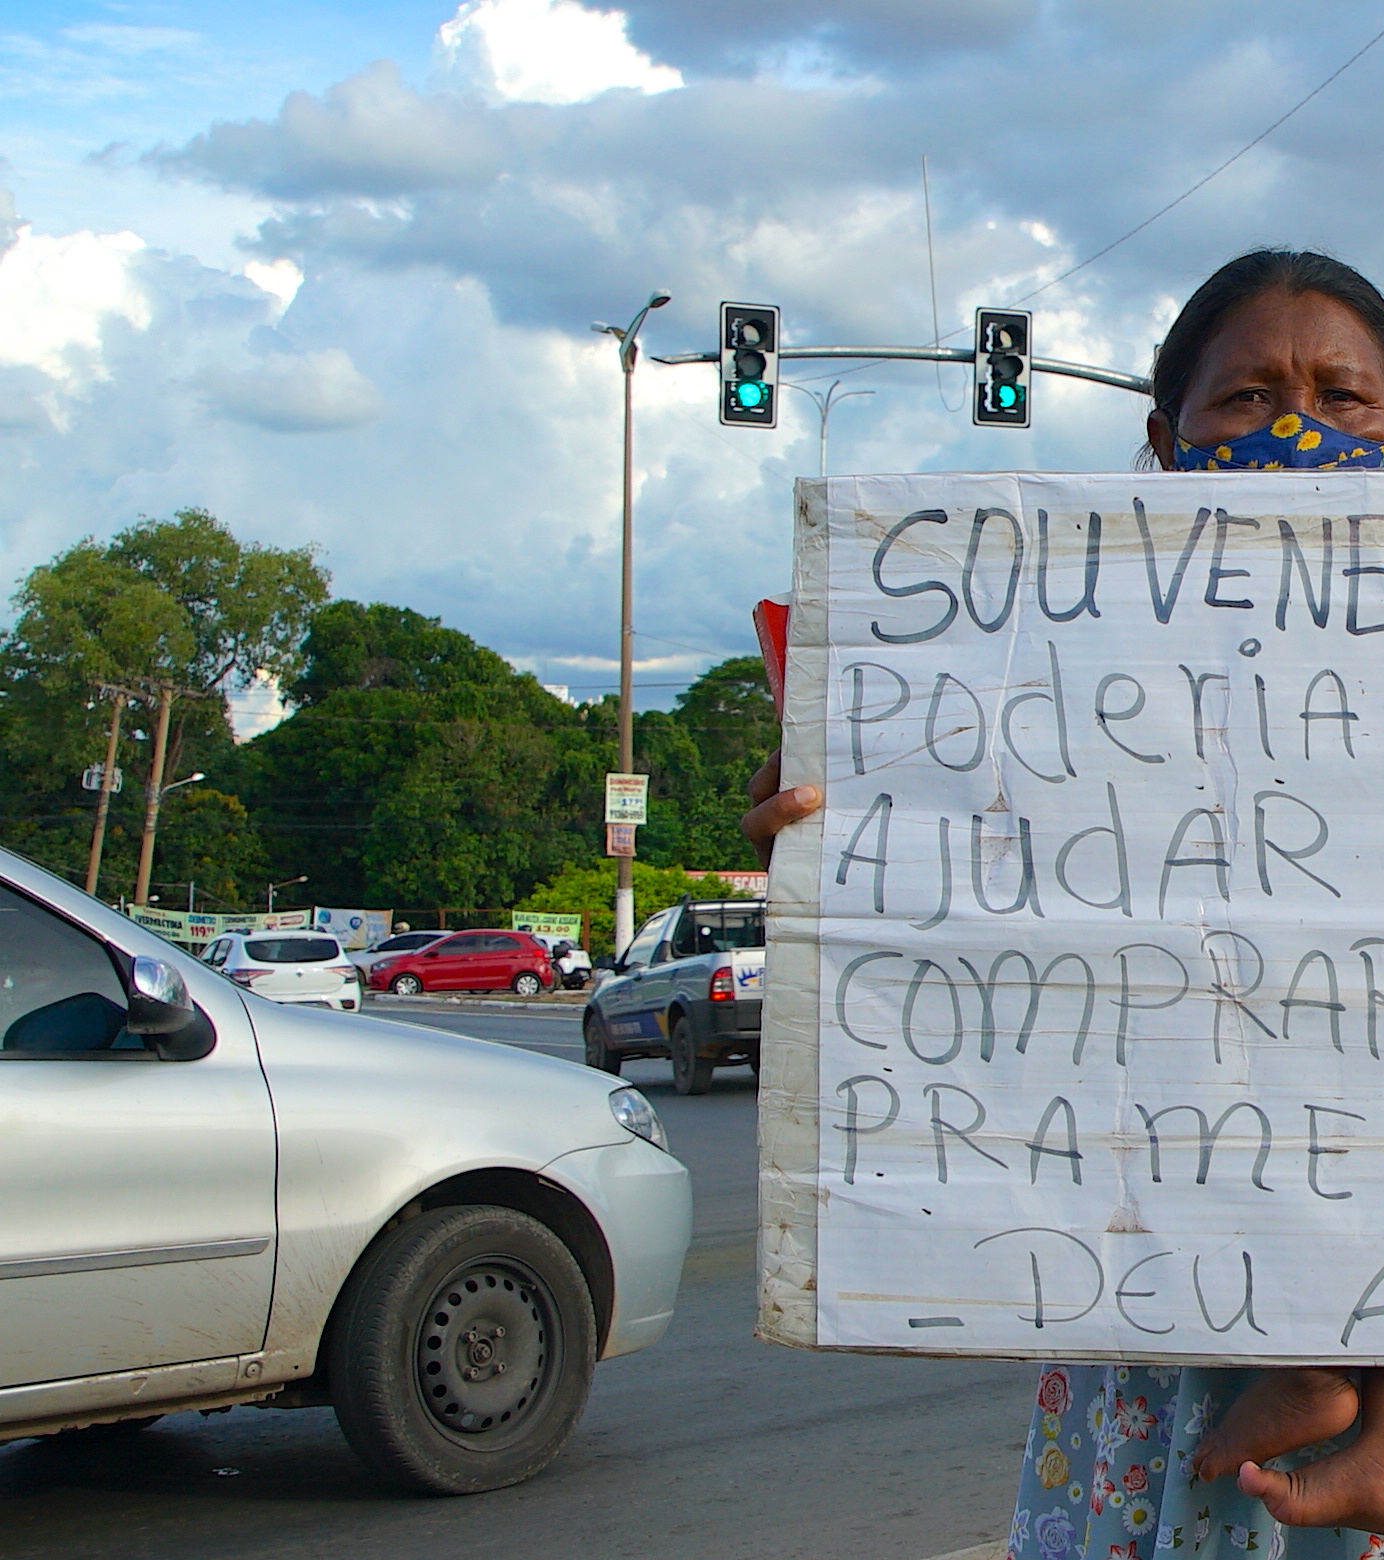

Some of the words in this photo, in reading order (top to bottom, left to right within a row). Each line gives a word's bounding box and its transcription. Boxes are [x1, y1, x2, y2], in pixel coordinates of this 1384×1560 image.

[871, 507, 1101, 644] SOU
[832, 1074, 1083, 1186] PRA
[974, 1227, 1268, 1337] DEU
